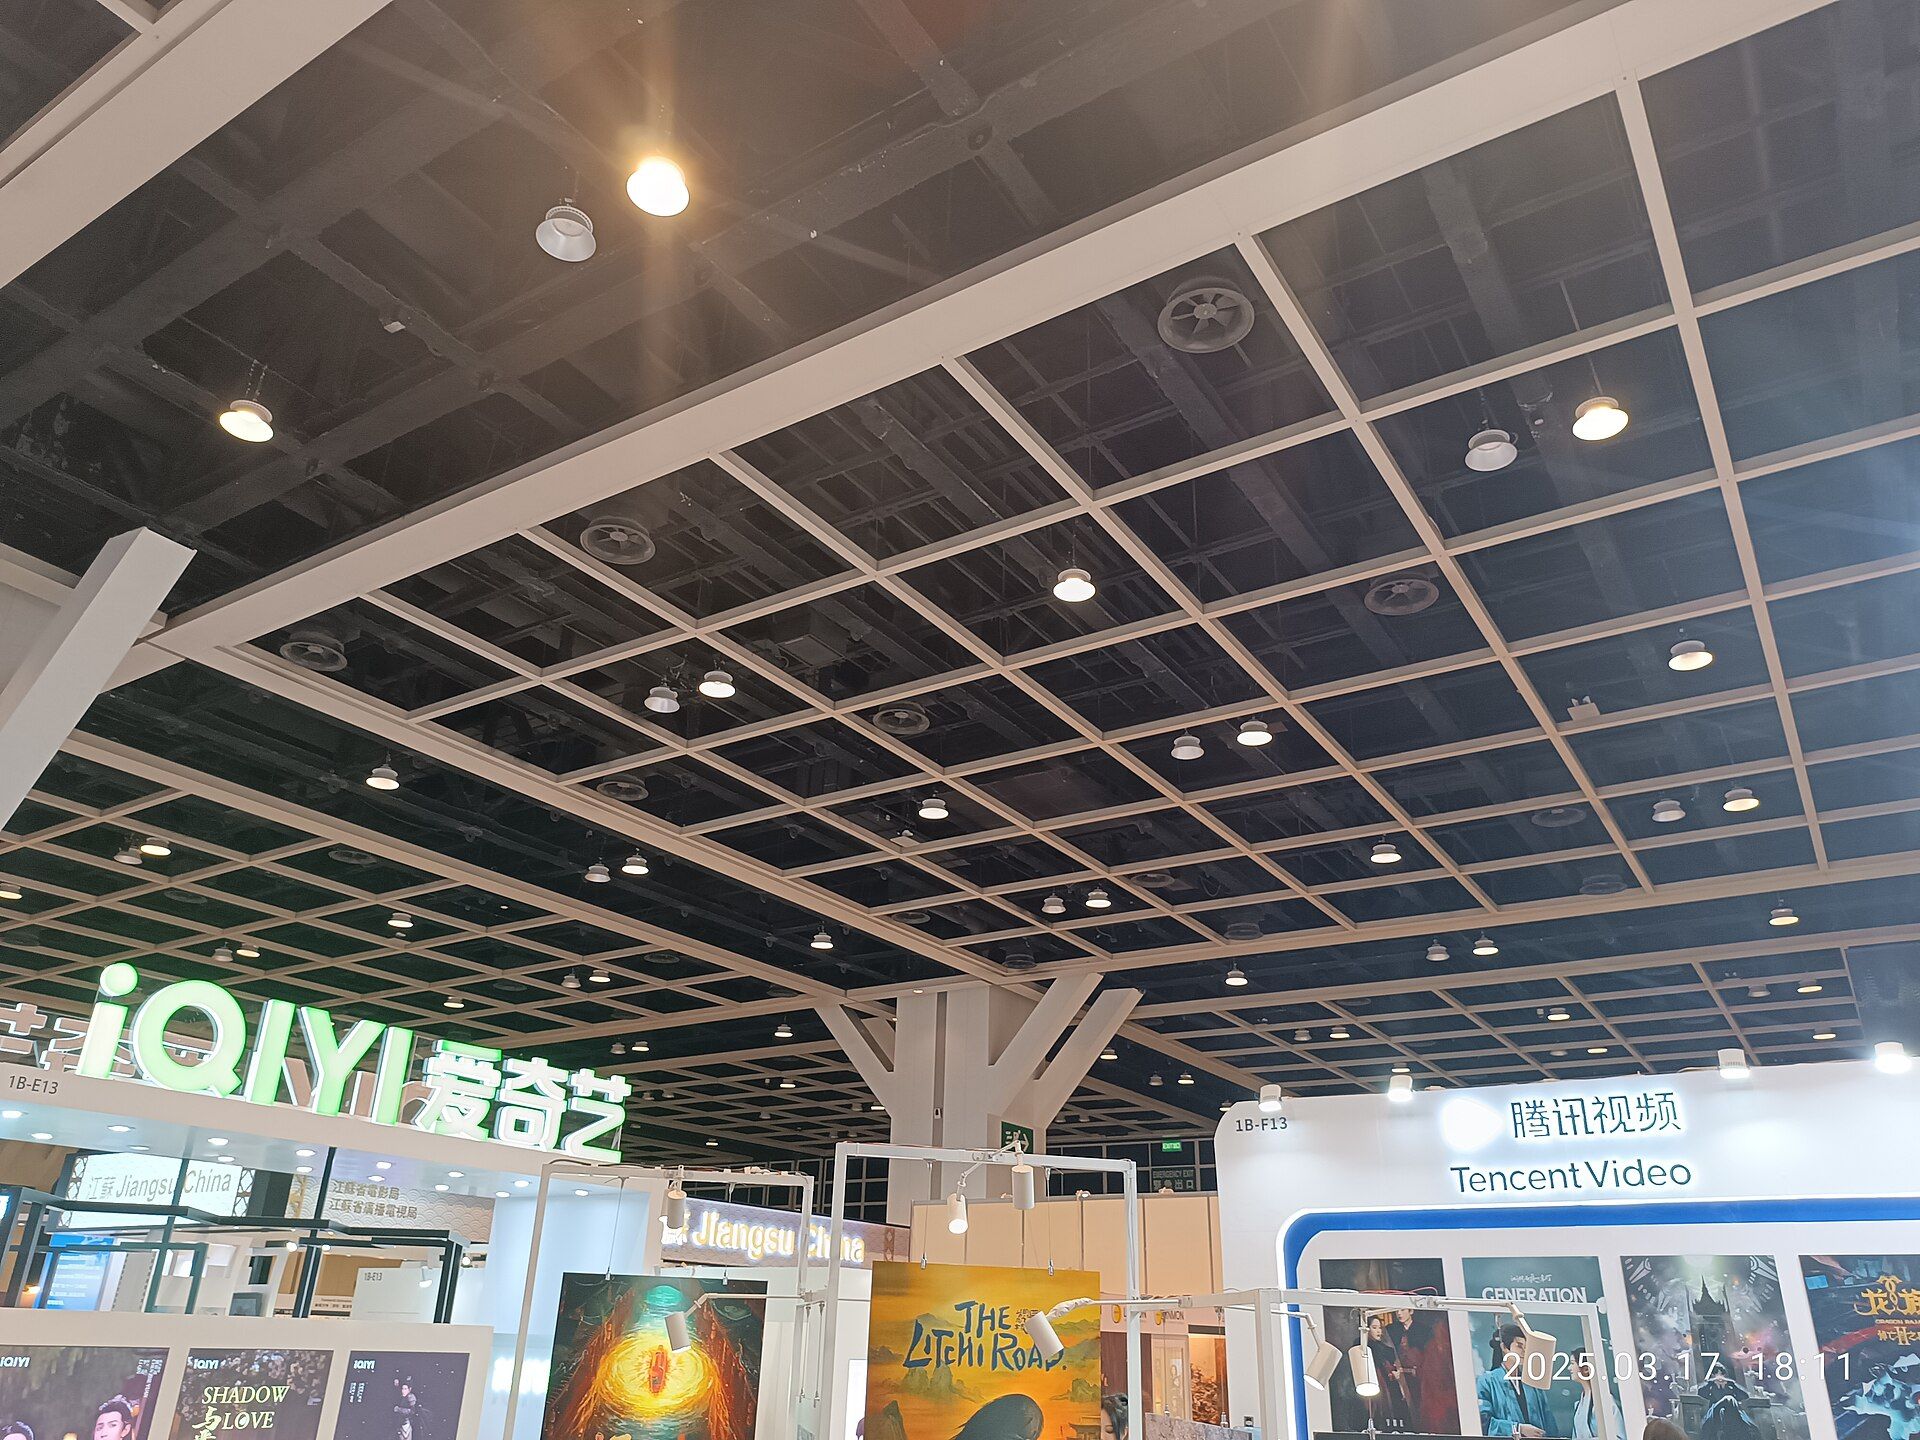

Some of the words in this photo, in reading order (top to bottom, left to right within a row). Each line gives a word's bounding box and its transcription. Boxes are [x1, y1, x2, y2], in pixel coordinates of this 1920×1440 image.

[75, 962, 414, 1126] iQIYI
[8, 1075, 59, 1095] 1B-E13
[413, 1040, 632, 1164] 爱奇艺
[1511, 1091, 1683, 1139] 腾讯视频
[1235, 1116, 1289, 1133] 1B-F13
[184, 1168, 232, 1194] China
[1449, 1162, 1583, 1194] Tencent
[1584, 1157, 1692, 1188] Video
[692, 1210, 795, 1260] Jiangsu
[804, 1222, 866, 1263] Chna
[1482, 1286, 1586, 1303] GENERATION
[954, 1300, 1012, 1338] THE
[201, 1385, 291, 1404] SHADOW
[221, 1411, 275, 1430] LOVE
